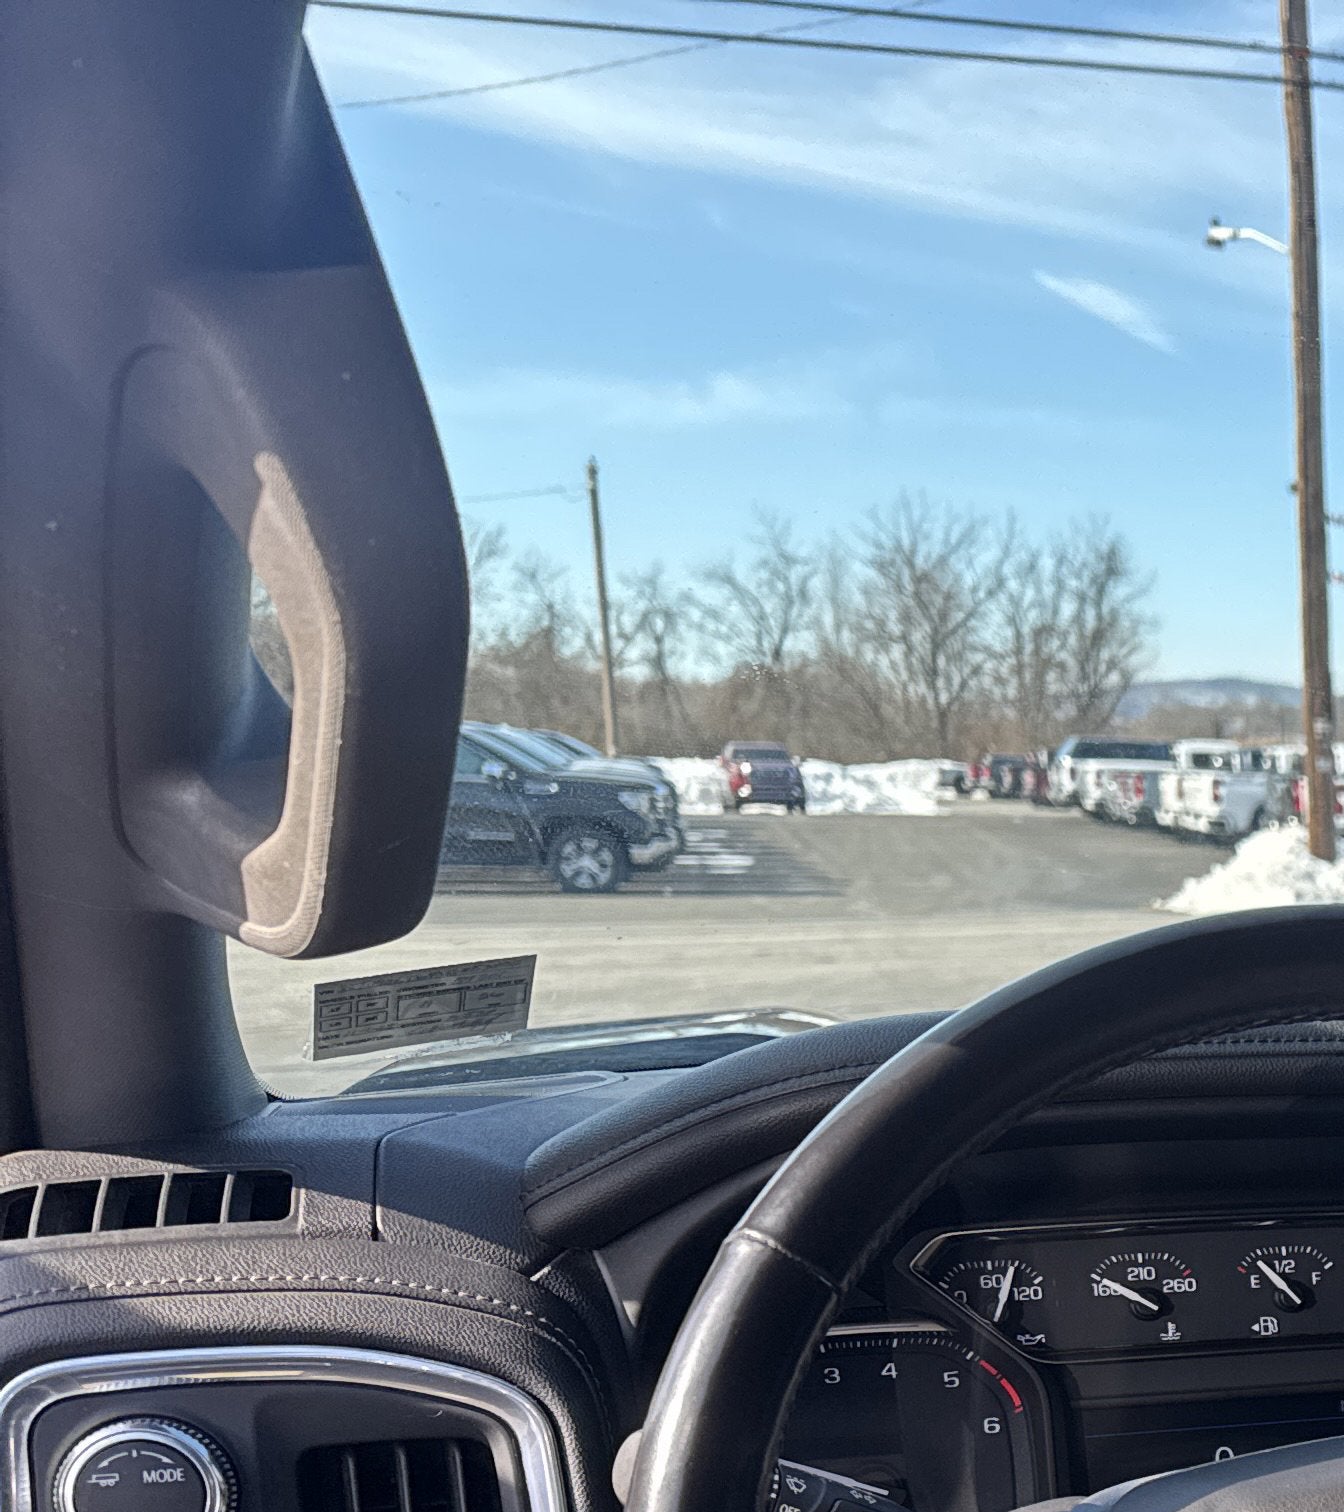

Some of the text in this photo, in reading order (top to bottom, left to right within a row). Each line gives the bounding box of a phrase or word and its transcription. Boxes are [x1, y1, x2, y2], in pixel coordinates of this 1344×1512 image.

[1127, 1266, 1156, 1281] 210
[1273, 1259, 1296, 1274] 1/2
[980, 1274, 1004, 1289] 60
[1162, 1278, 1197, 1293] 260
[1250, 1274, 1261, 1289] E
[1311, 1271, 1321, 1286] F
[1013, 1286, 1043, 1301] 120
[824, 1367, 841, 1384] 3
[881, 1362, 898, 1379] 4
[943, 1371, 960, 1388] 5
[983, 1417, 1001, 1434] 6
[142, 1467, 187, 1483] MODE
